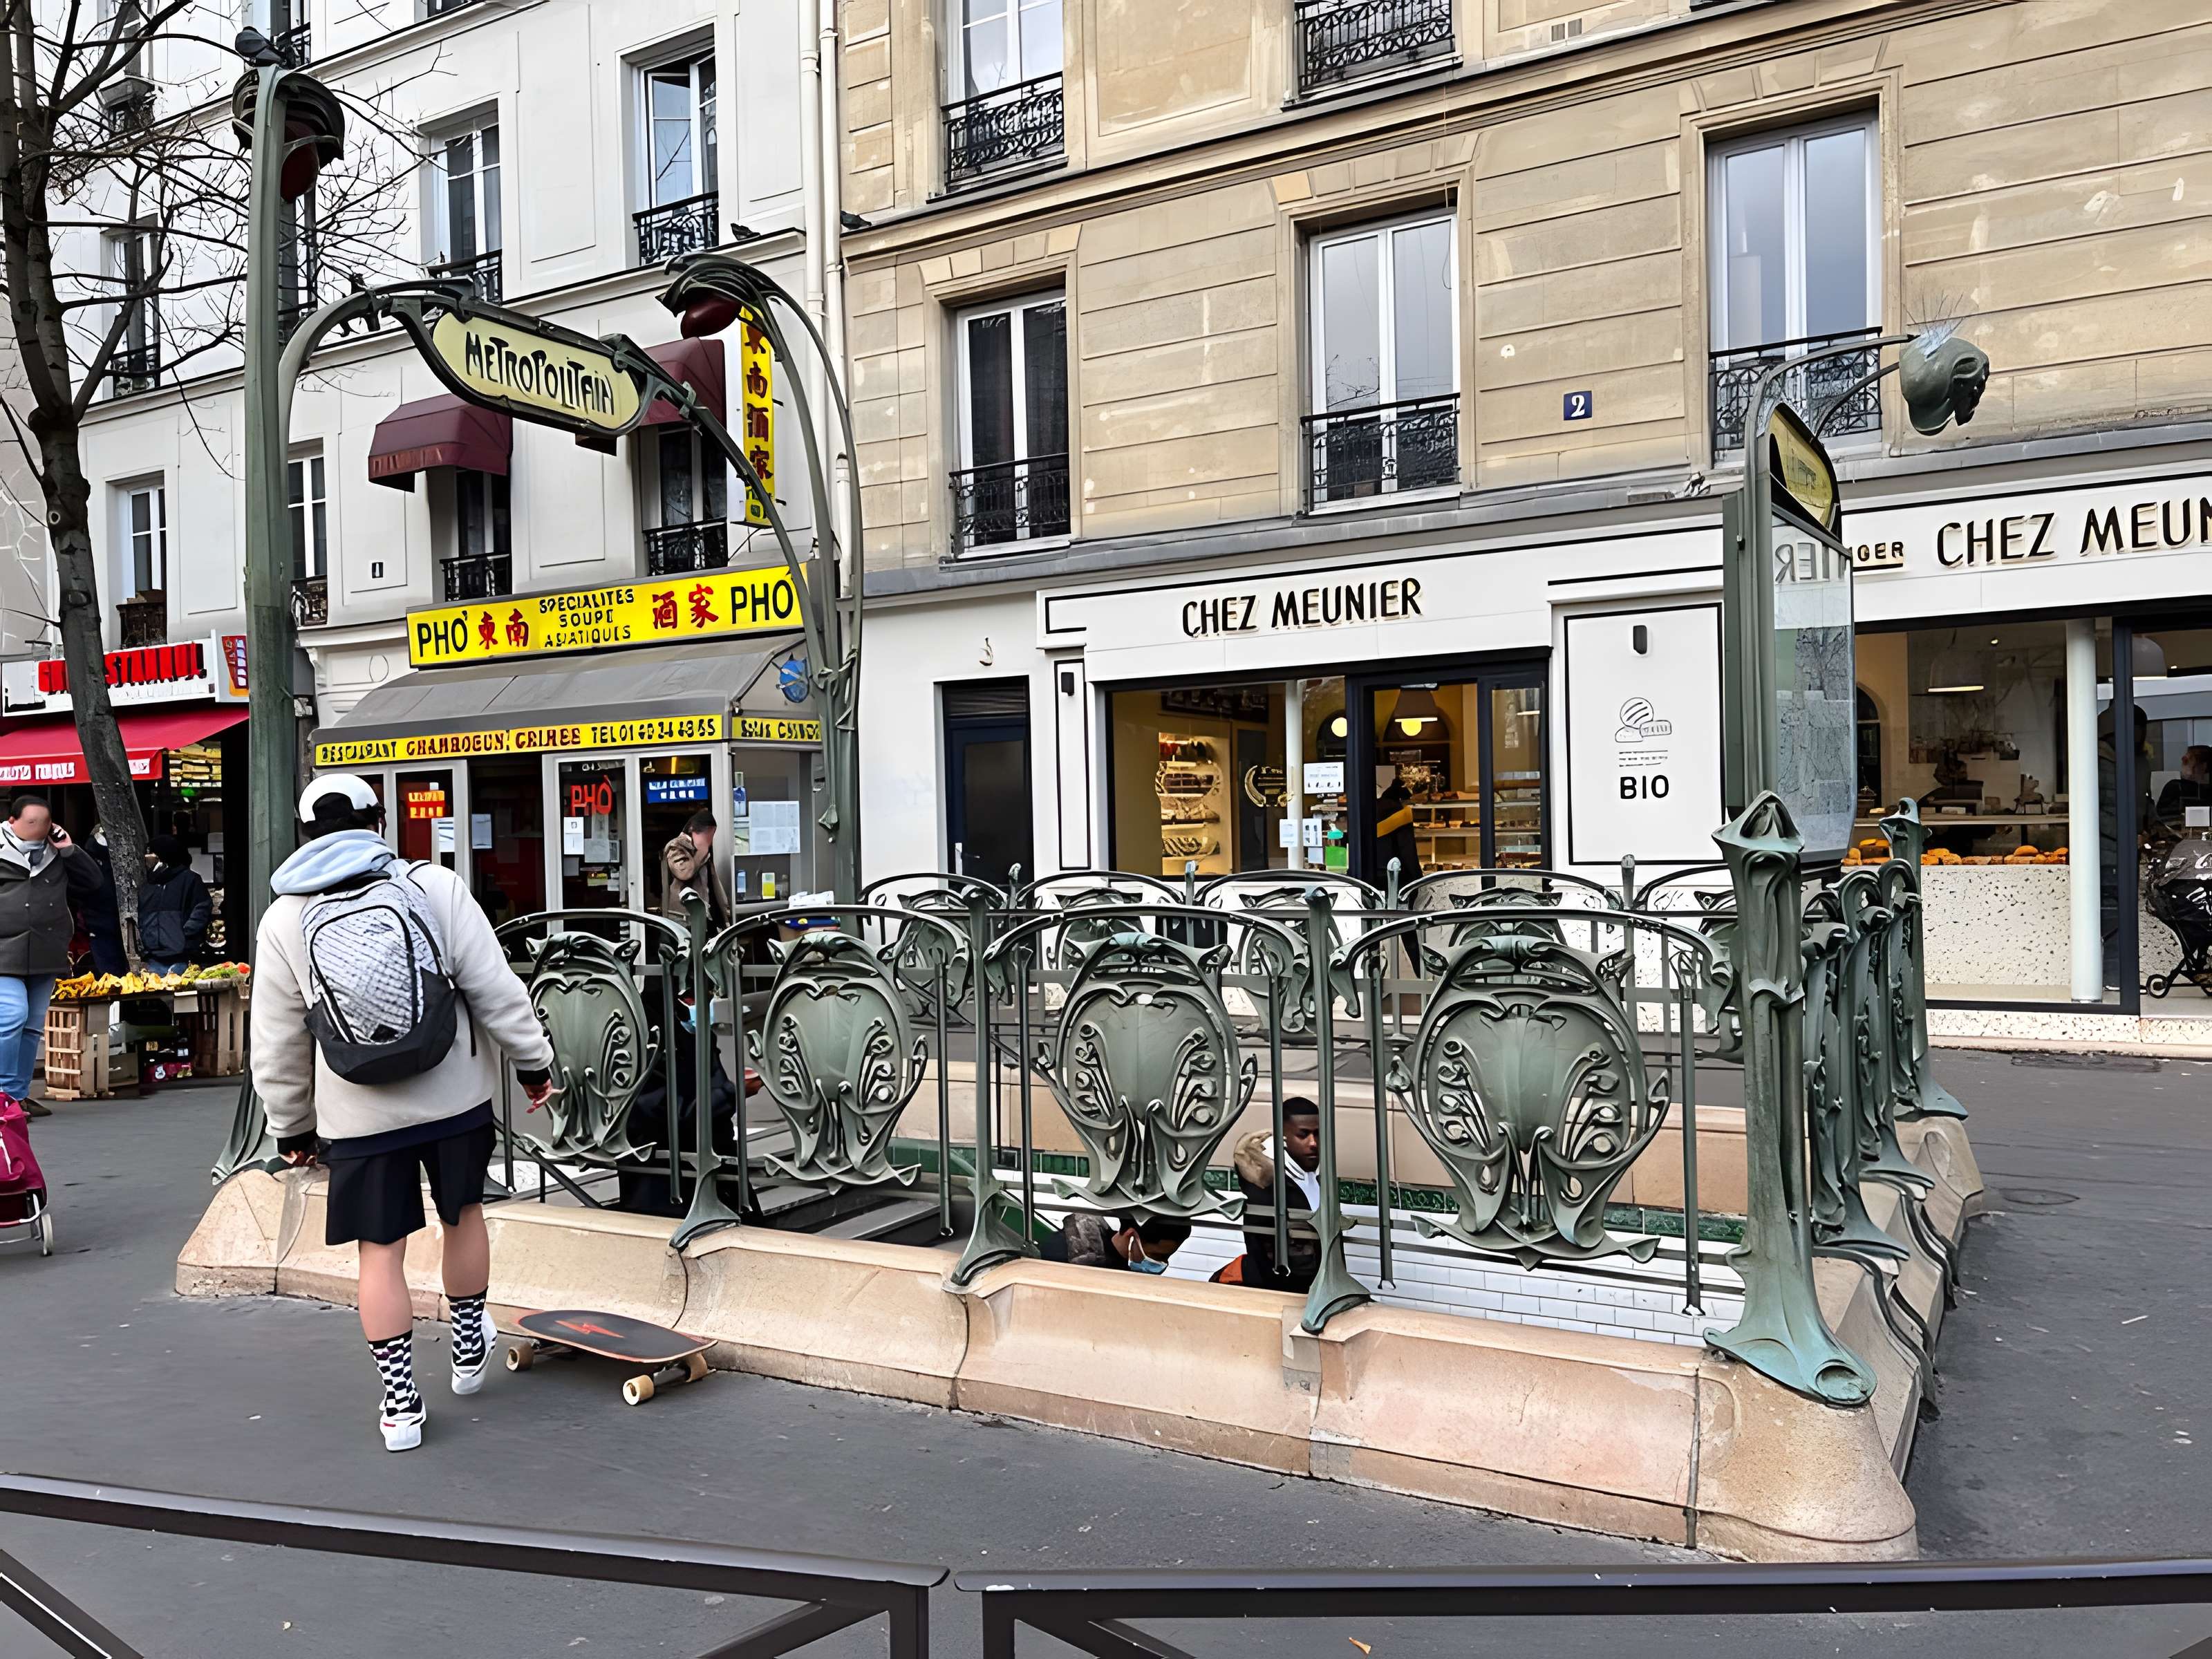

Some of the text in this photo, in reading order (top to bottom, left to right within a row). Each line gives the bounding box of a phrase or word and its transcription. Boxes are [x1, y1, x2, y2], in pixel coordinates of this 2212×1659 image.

[466, 331, 614, 415] METROPOLITAIN
[1571, 395, 1585, 417] 2
[1937, 512, 2055, 566] CHEZ
[539, 588, 634, 614] SPECIALITES
[1182, 577, 1421, 637] CHEZ MEUNIER
[1620, 775, 1669, 799] BIO
